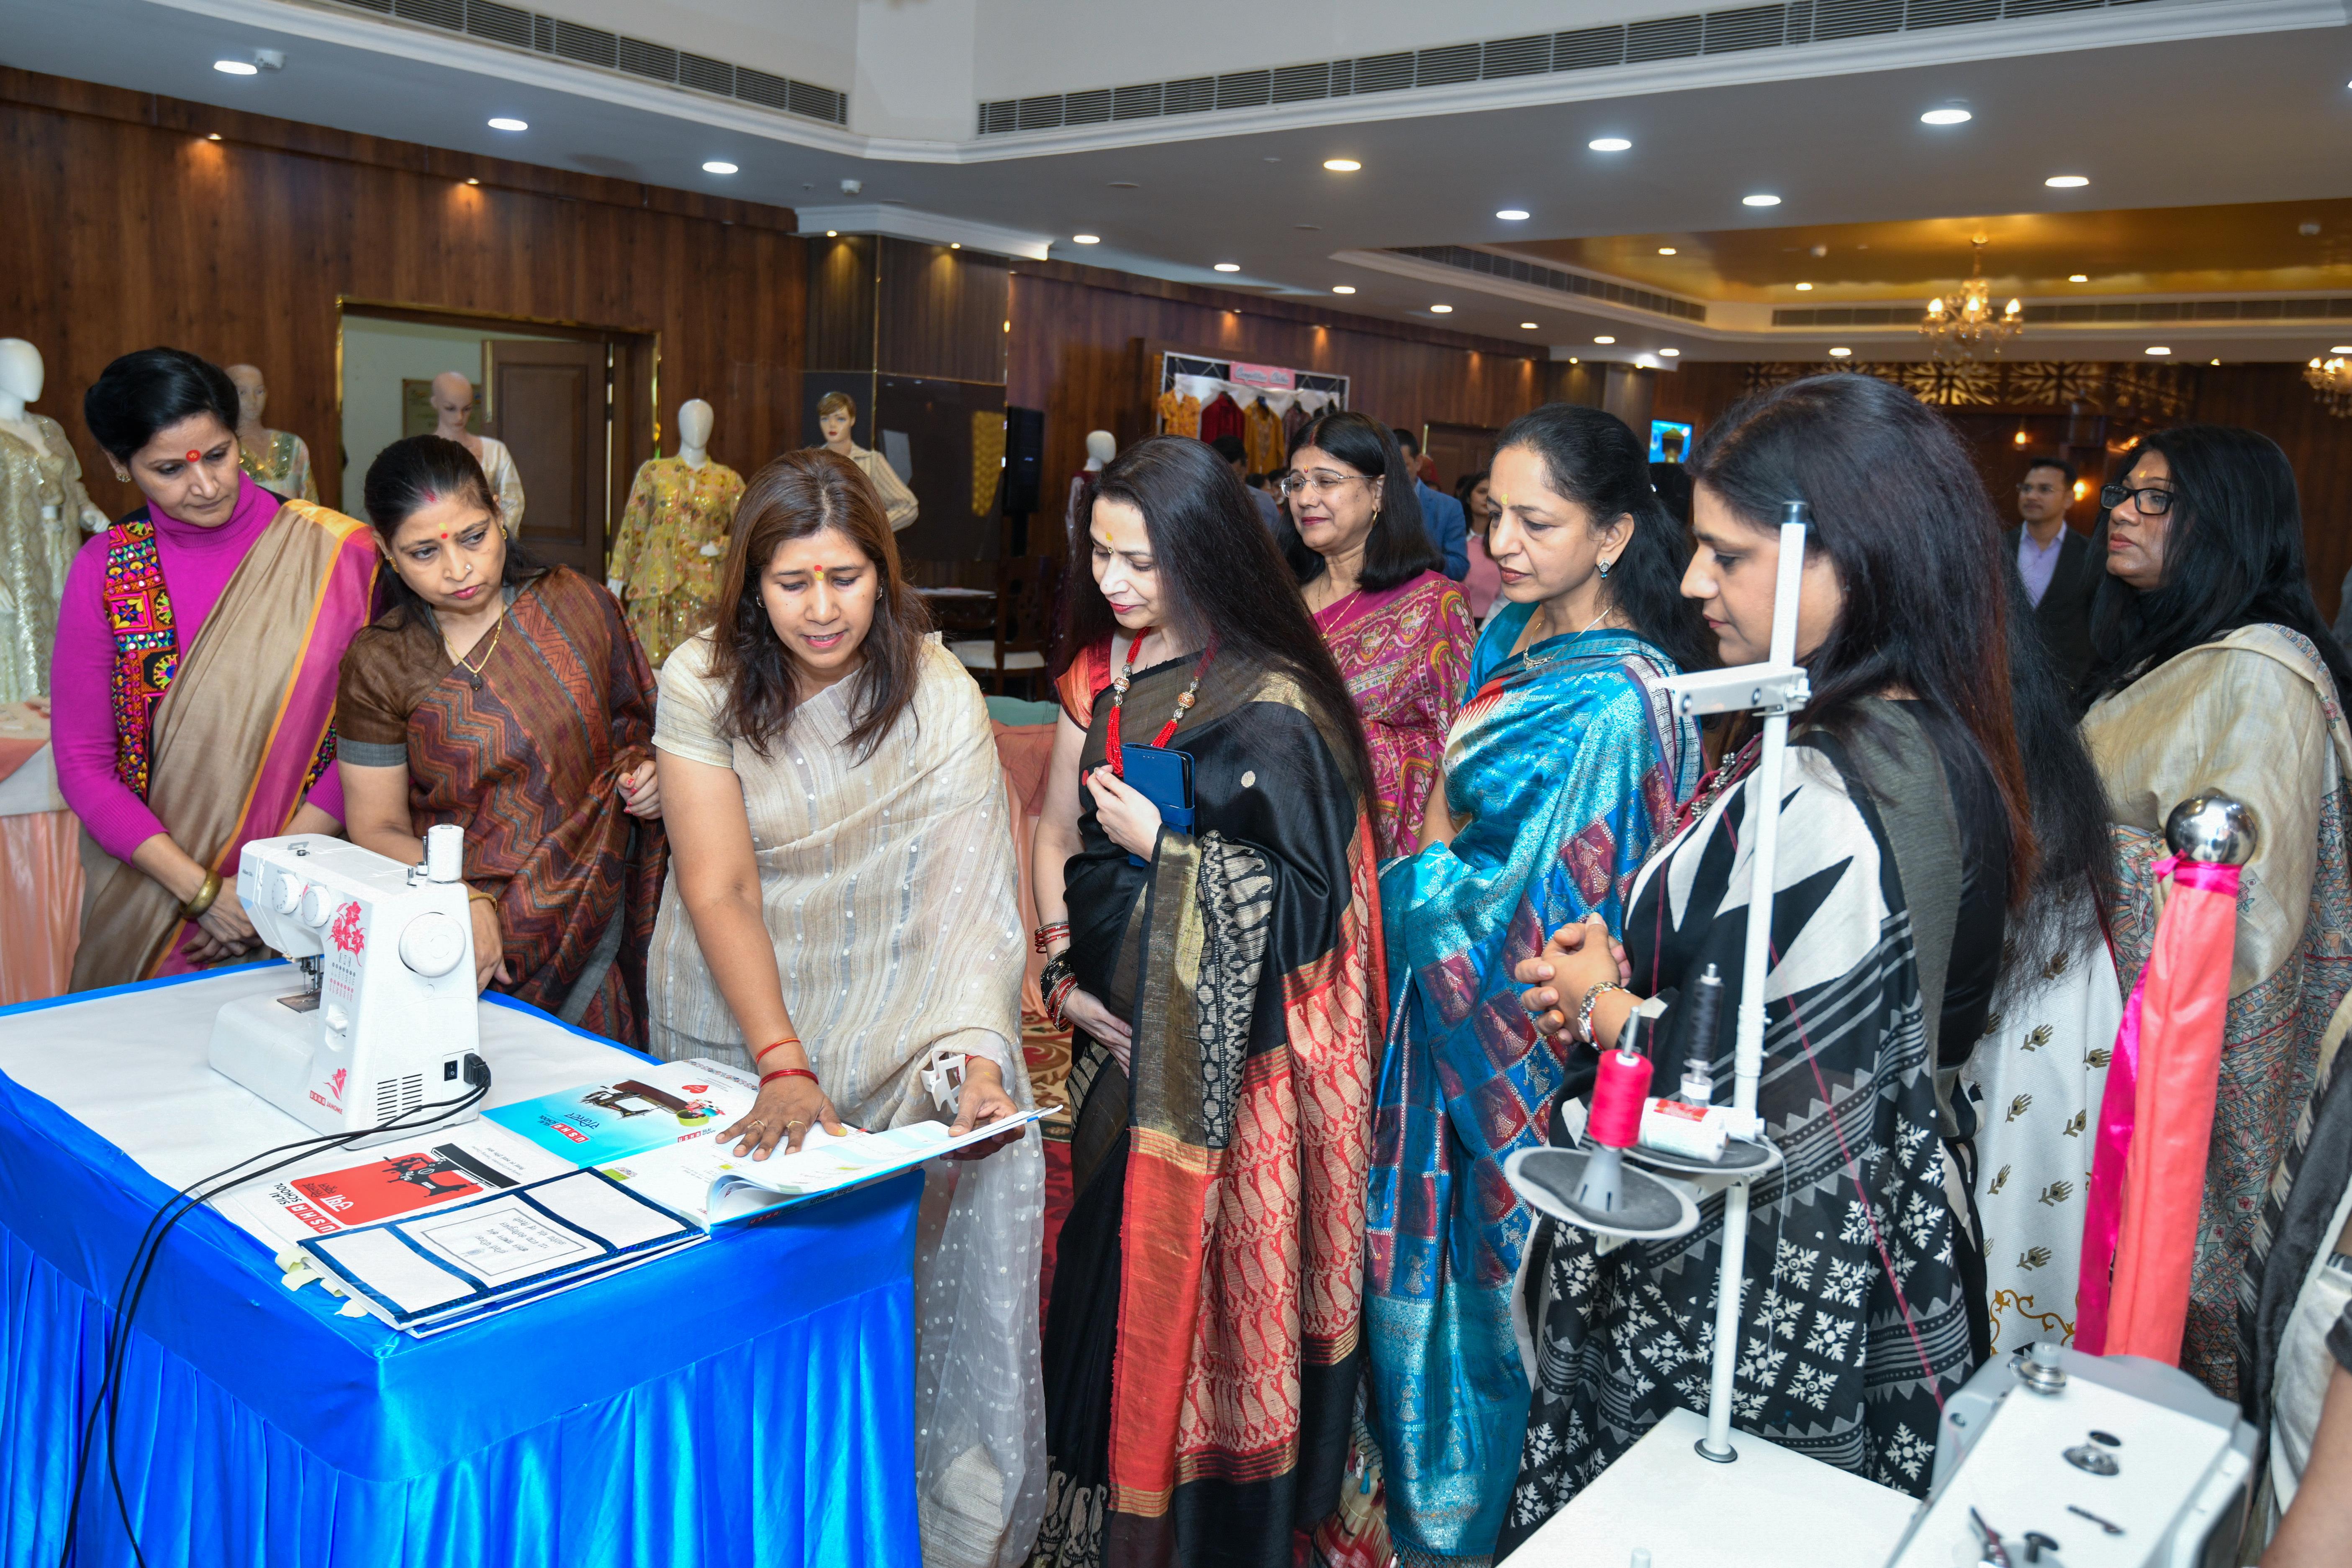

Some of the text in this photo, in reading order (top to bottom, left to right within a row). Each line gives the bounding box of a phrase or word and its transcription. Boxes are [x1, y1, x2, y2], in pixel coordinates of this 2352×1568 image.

[310, 1091, 343, 1115] USHA JANOME
[538, 1115, 559, 1124] SCHOOL
[563, 1112, 600, 1129] रजिस्टर
[553, 1124, 586, 1142] USHA
[678, 1132, 701, 1142] USHA
[273, 1183, 302, 1203] SCHOOL
[318, 1183, 337, 1194] स्कूल
[298, 1183, 354, 1212] उषा सिलाई
[268, 1193, 336, 1232] USHA SILAI
[749, 1211, 779, 1225] USHA
